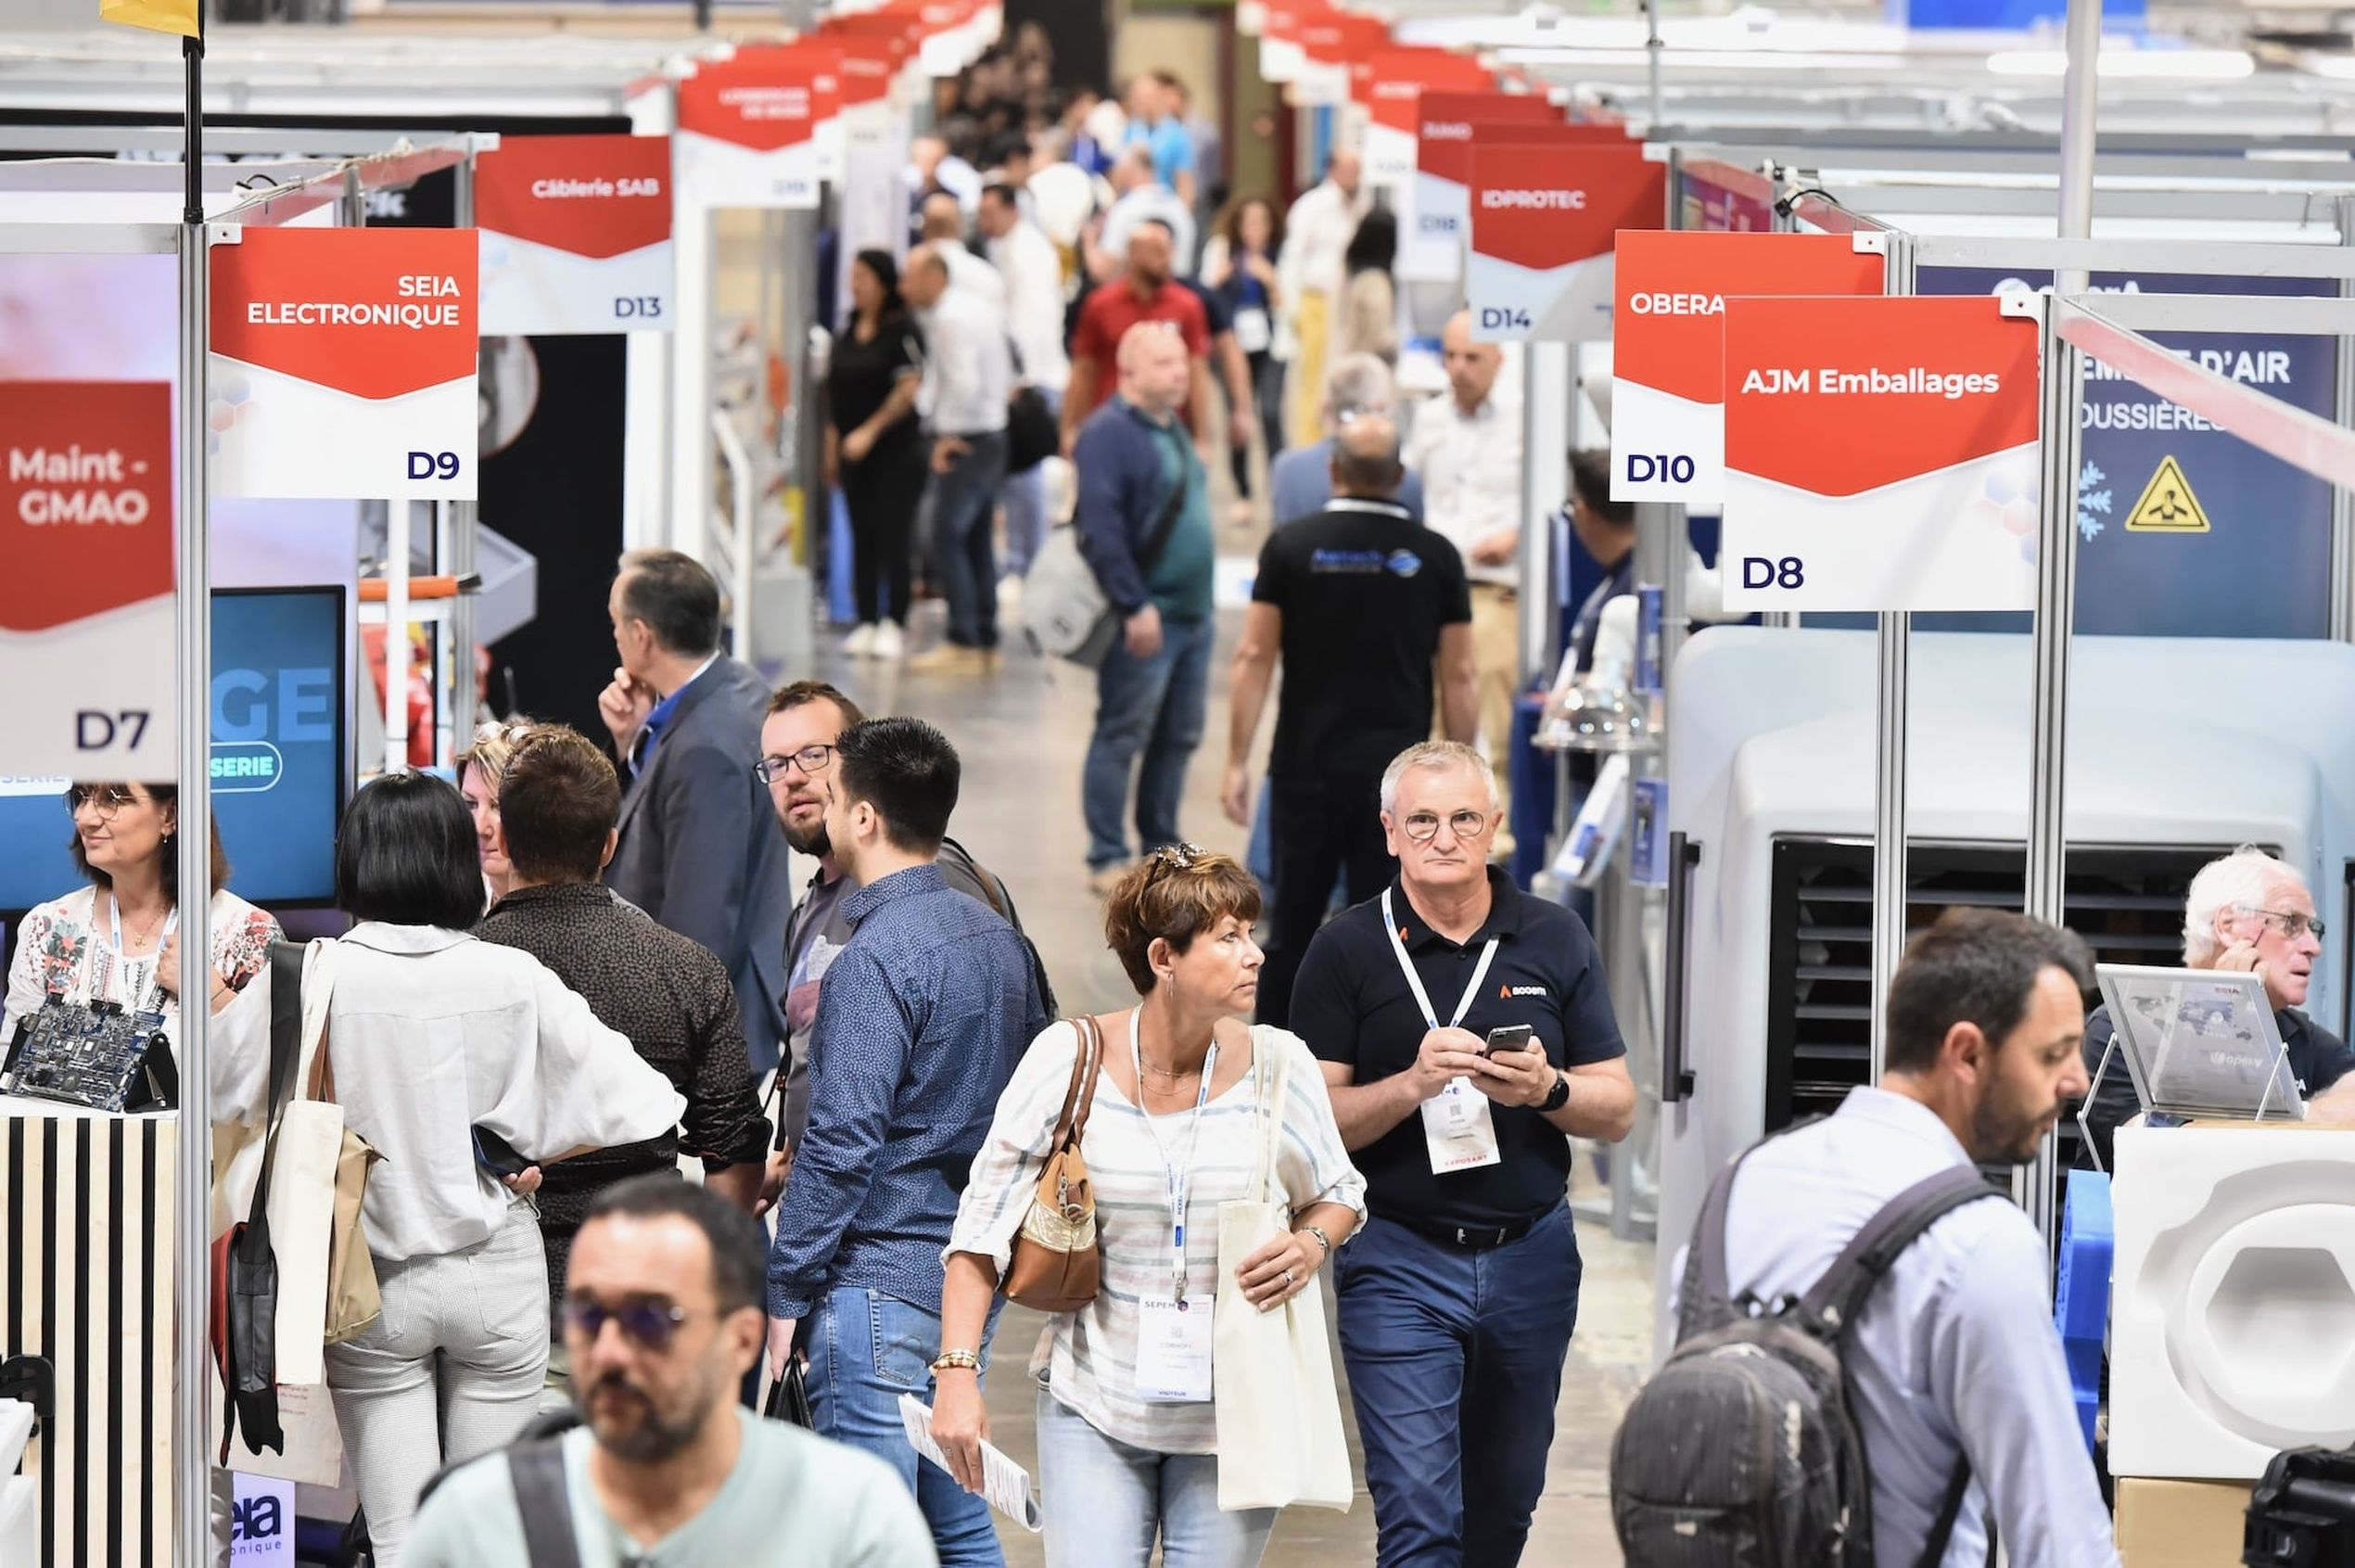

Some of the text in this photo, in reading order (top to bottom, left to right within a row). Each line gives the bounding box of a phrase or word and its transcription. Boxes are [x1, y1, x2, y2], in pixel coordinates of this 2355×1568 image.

[532, 177, 659, 198] Câblerie SAB
[1482, 190, 1585, 210] IDPROTEC
[398, 274, 461, 297] SEIA
[247, 302, 460, 329] ELECTRONIQUE
[615, 297, 661, 318] D13
[1630, 293, 1725, 315] OBERA
[1482, 308, 1532, 329] D14
[1741, 367, 2000, 399] AJM Emballages
[8, 444, 125, 484] Maint
[407, 452, 460, 480] D9
[1627, 454, 1695, 483] D10
[18, 489, 149, 526] GMAO
[1743, 556, 1804, 589] D8
[210, 668, 332, 742] GE
[75, 710, 150, 751] D7
[210, 756, 274, 778] SERIE
